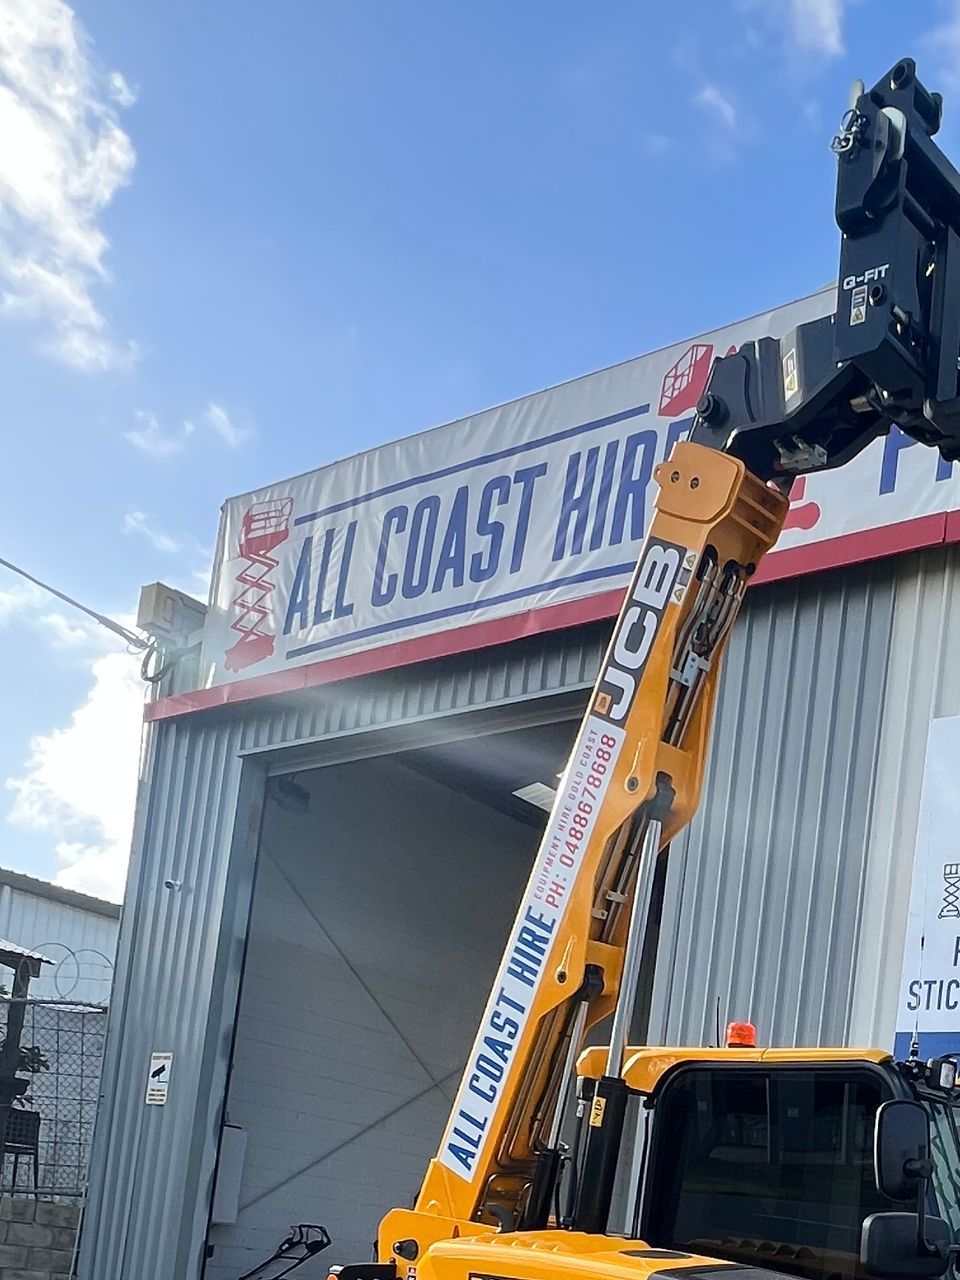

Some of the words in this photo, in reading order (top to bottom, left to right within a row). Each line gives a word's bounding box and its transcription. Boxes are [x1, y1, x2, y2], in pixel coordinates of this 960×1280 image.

[283, 521, 358, 636] ALL
[371, 462, 549, 608] COAST
[604, 545, 680, 720] JCB
[533, 836, 562, 900] EQUIPMENT
[557, 806, 573, 832] HIRE
[580, 729, 599, 768] COAST
[544, 873, 567, 909] PH:
[559, 734, 616, 868] 0488678688
[447, 1109, 489, 1171] ALL
[468, 987, 526, 1104] COAST
[506, 905, 557, 988] HIRE
